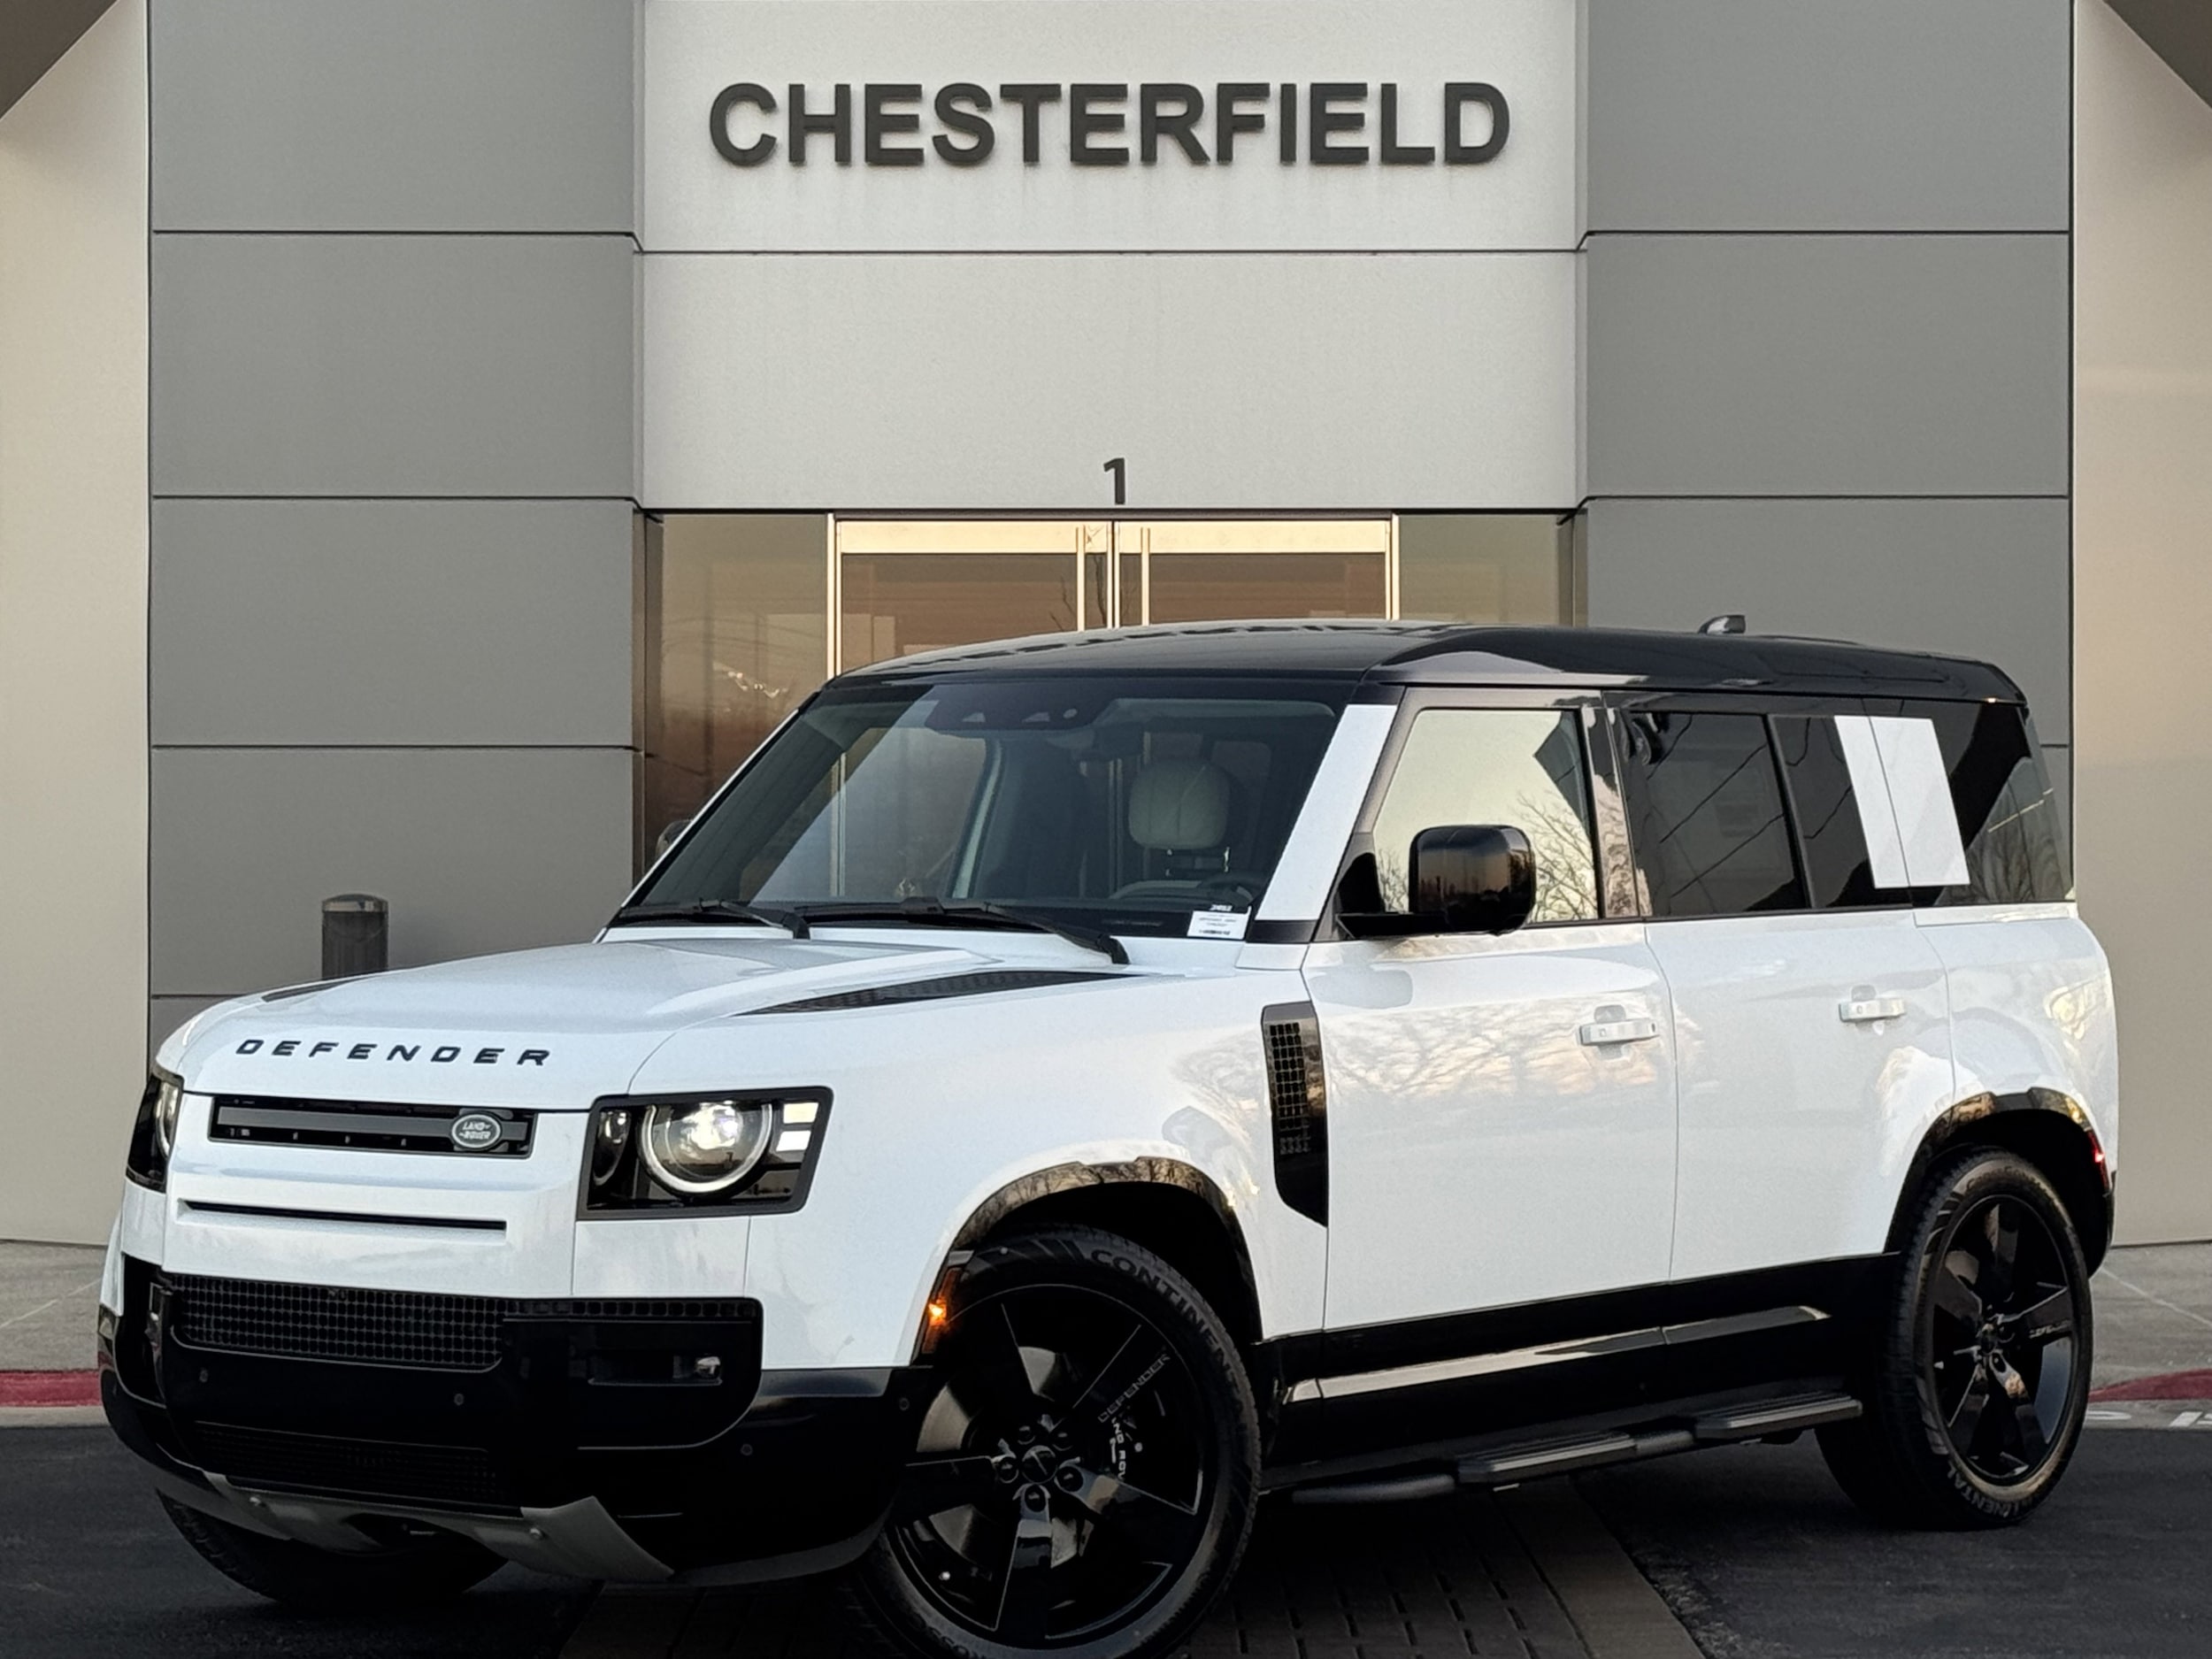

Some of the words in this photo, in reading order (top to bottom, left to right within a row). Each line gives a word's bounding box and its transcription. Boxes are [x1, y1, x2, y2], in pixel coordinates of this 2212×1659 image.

[709, 82, 1511, 165] CHESTERFIELD
[1103, 457, 1125, 505] 1
[235, 1039, 551, 1066] DEFENDER
[1098, 1354, 1171, 1424] DEFENDER
